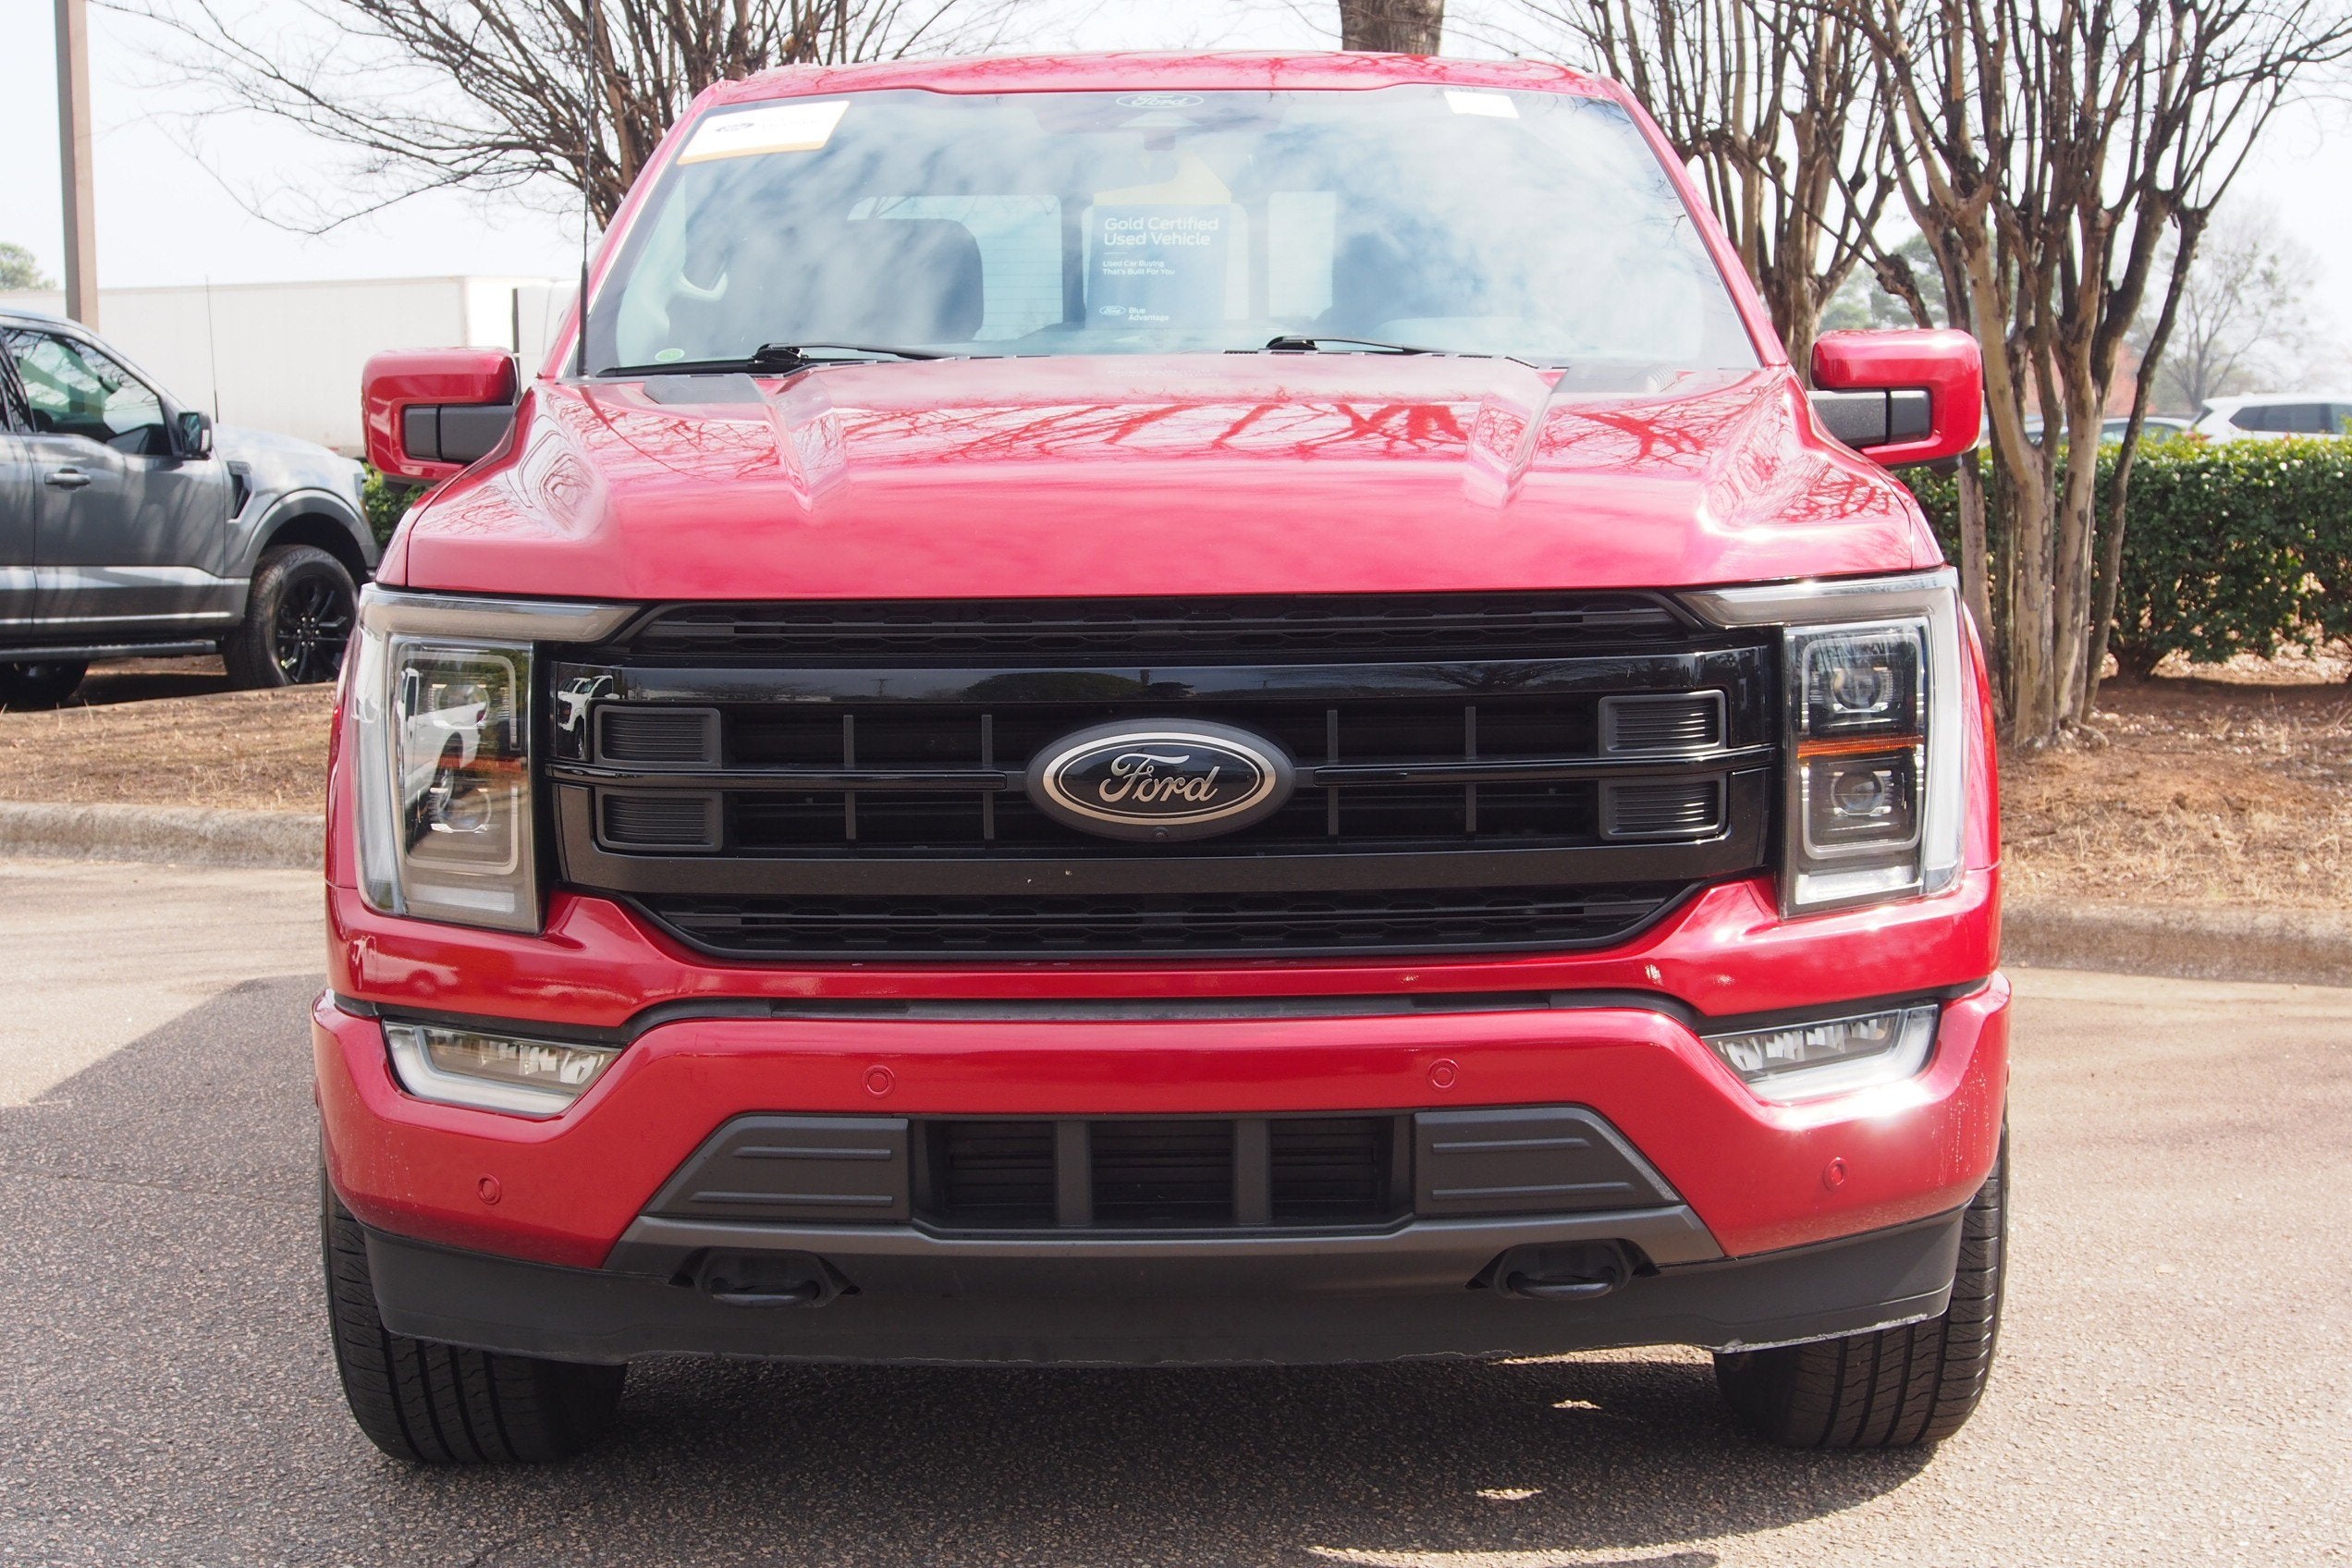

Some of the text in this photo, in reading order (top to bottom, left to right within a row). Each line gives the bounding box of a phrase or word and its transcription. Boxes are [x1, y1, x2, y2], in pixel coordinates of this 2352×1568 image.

[1131, 94, 1188, 106] Ford
[1104, 216, 1219, 230] Gold Certified
[1104, 232, 1211, 246] Used Vehicle
[1138, 260, 1165, 268] Buying
[1098, 753, 1220, 802] Ford
